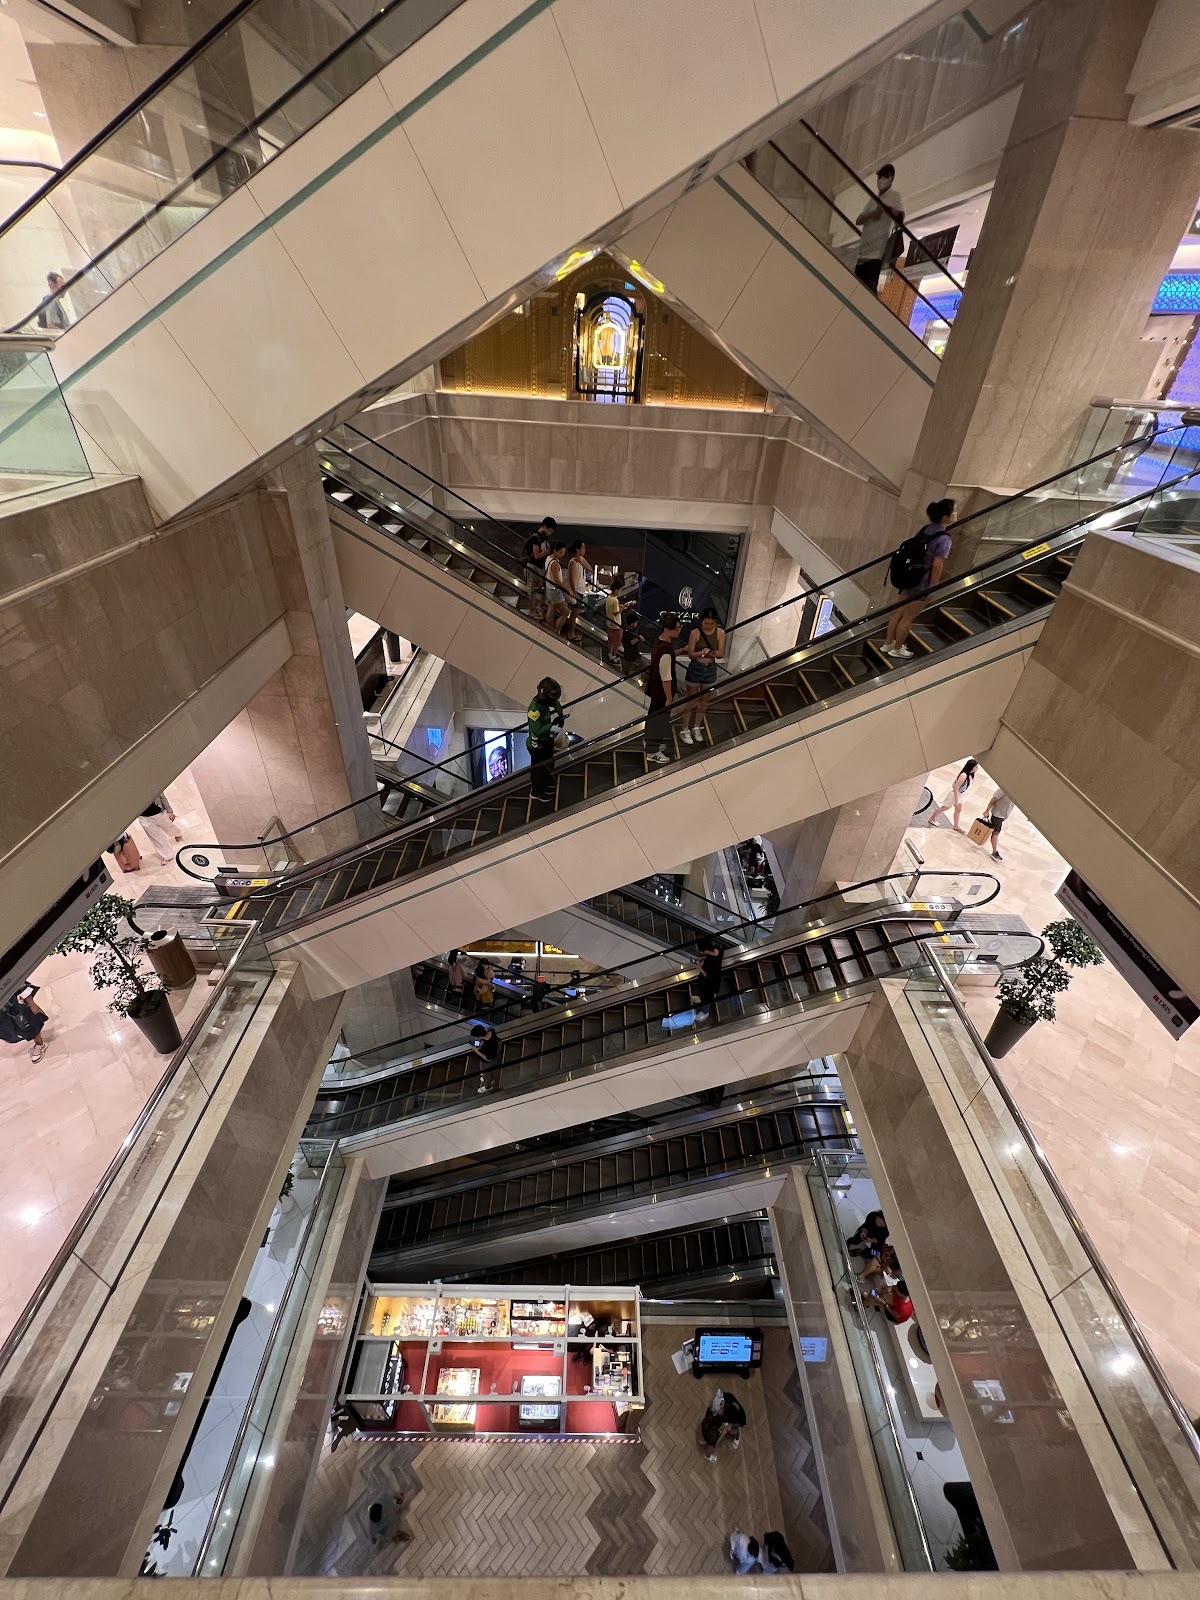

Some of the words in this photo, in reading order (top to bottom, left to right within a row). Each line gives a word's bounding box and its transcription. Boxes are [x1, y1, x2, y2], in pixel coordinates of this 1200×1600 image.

[659, 611, 700, 619] GYAR
[1107, 911, 1129, 938] Takashimaya
[1129, 936, 1147, 958] Shopping
[1146, 955, 1160, 971] Centre
[1158, 1000, 1171, 1014] DBS
